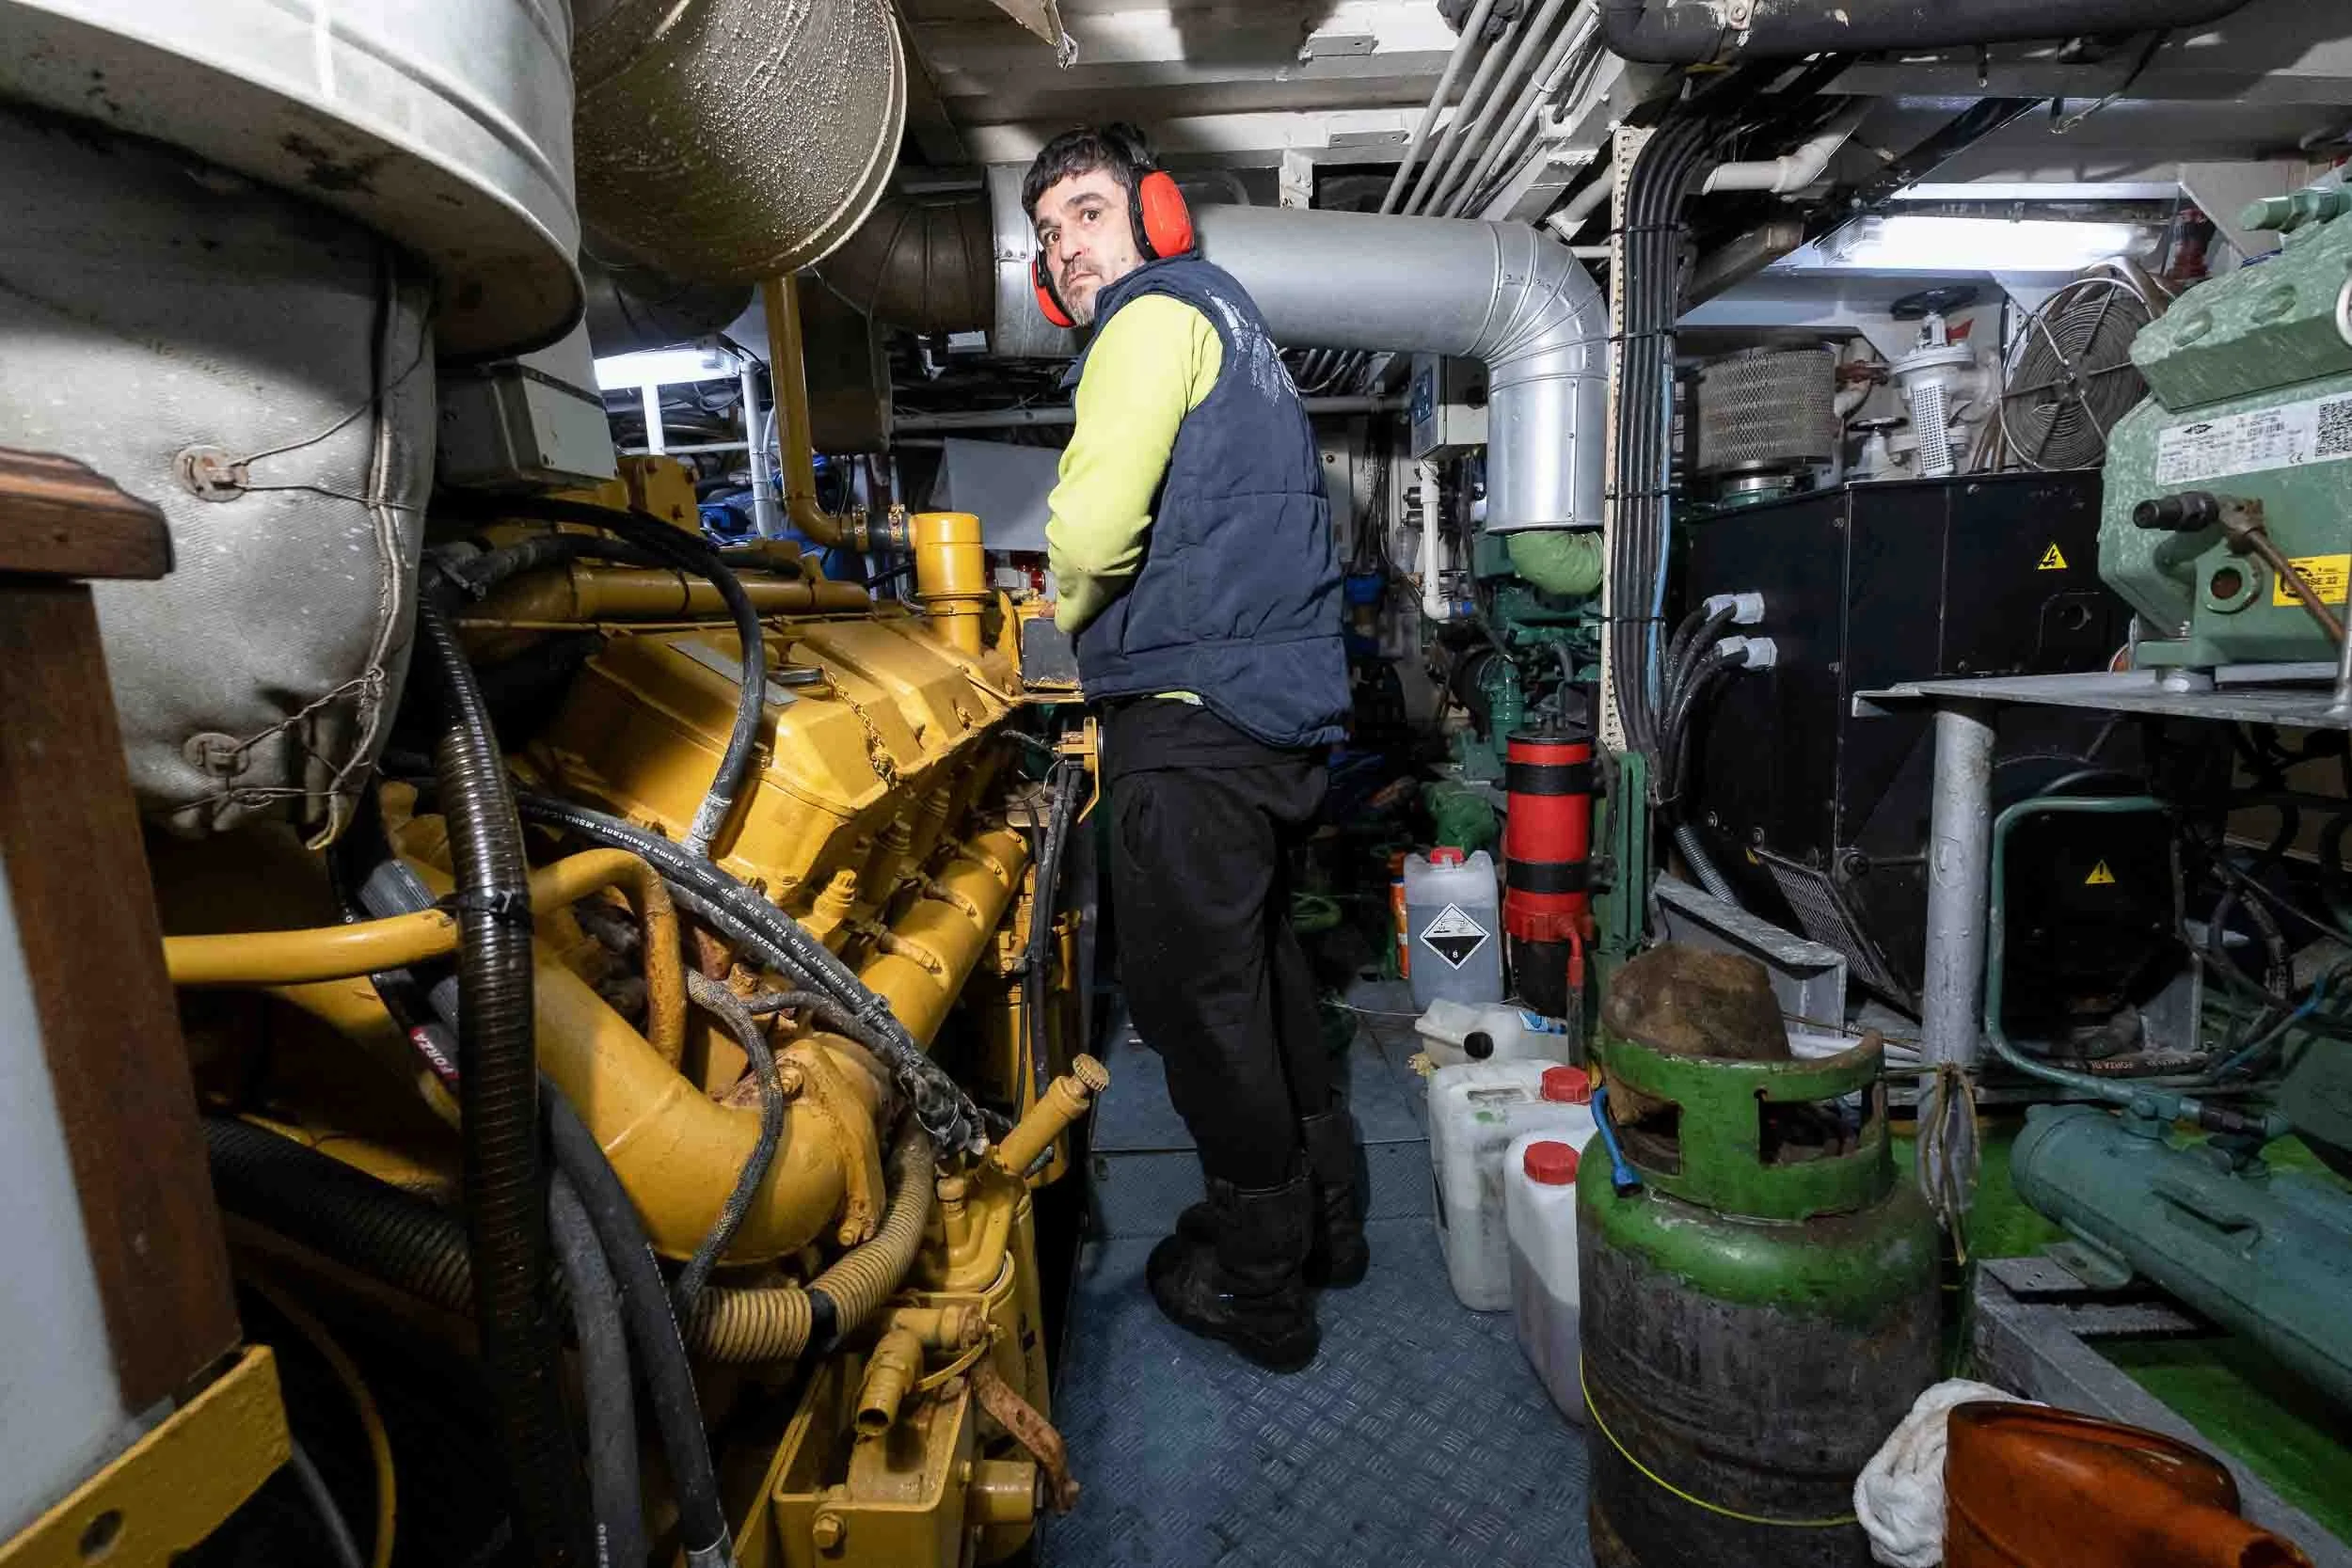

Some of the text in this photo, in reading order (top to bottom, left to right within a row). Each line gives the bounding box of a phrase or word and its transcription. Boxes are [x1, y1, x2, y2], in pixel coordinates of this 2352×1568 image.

[600, 826, 652, 851] Resistant
[651, 846, 684, 868] Flame
[413, 1033, 453, 1072] FORZA
